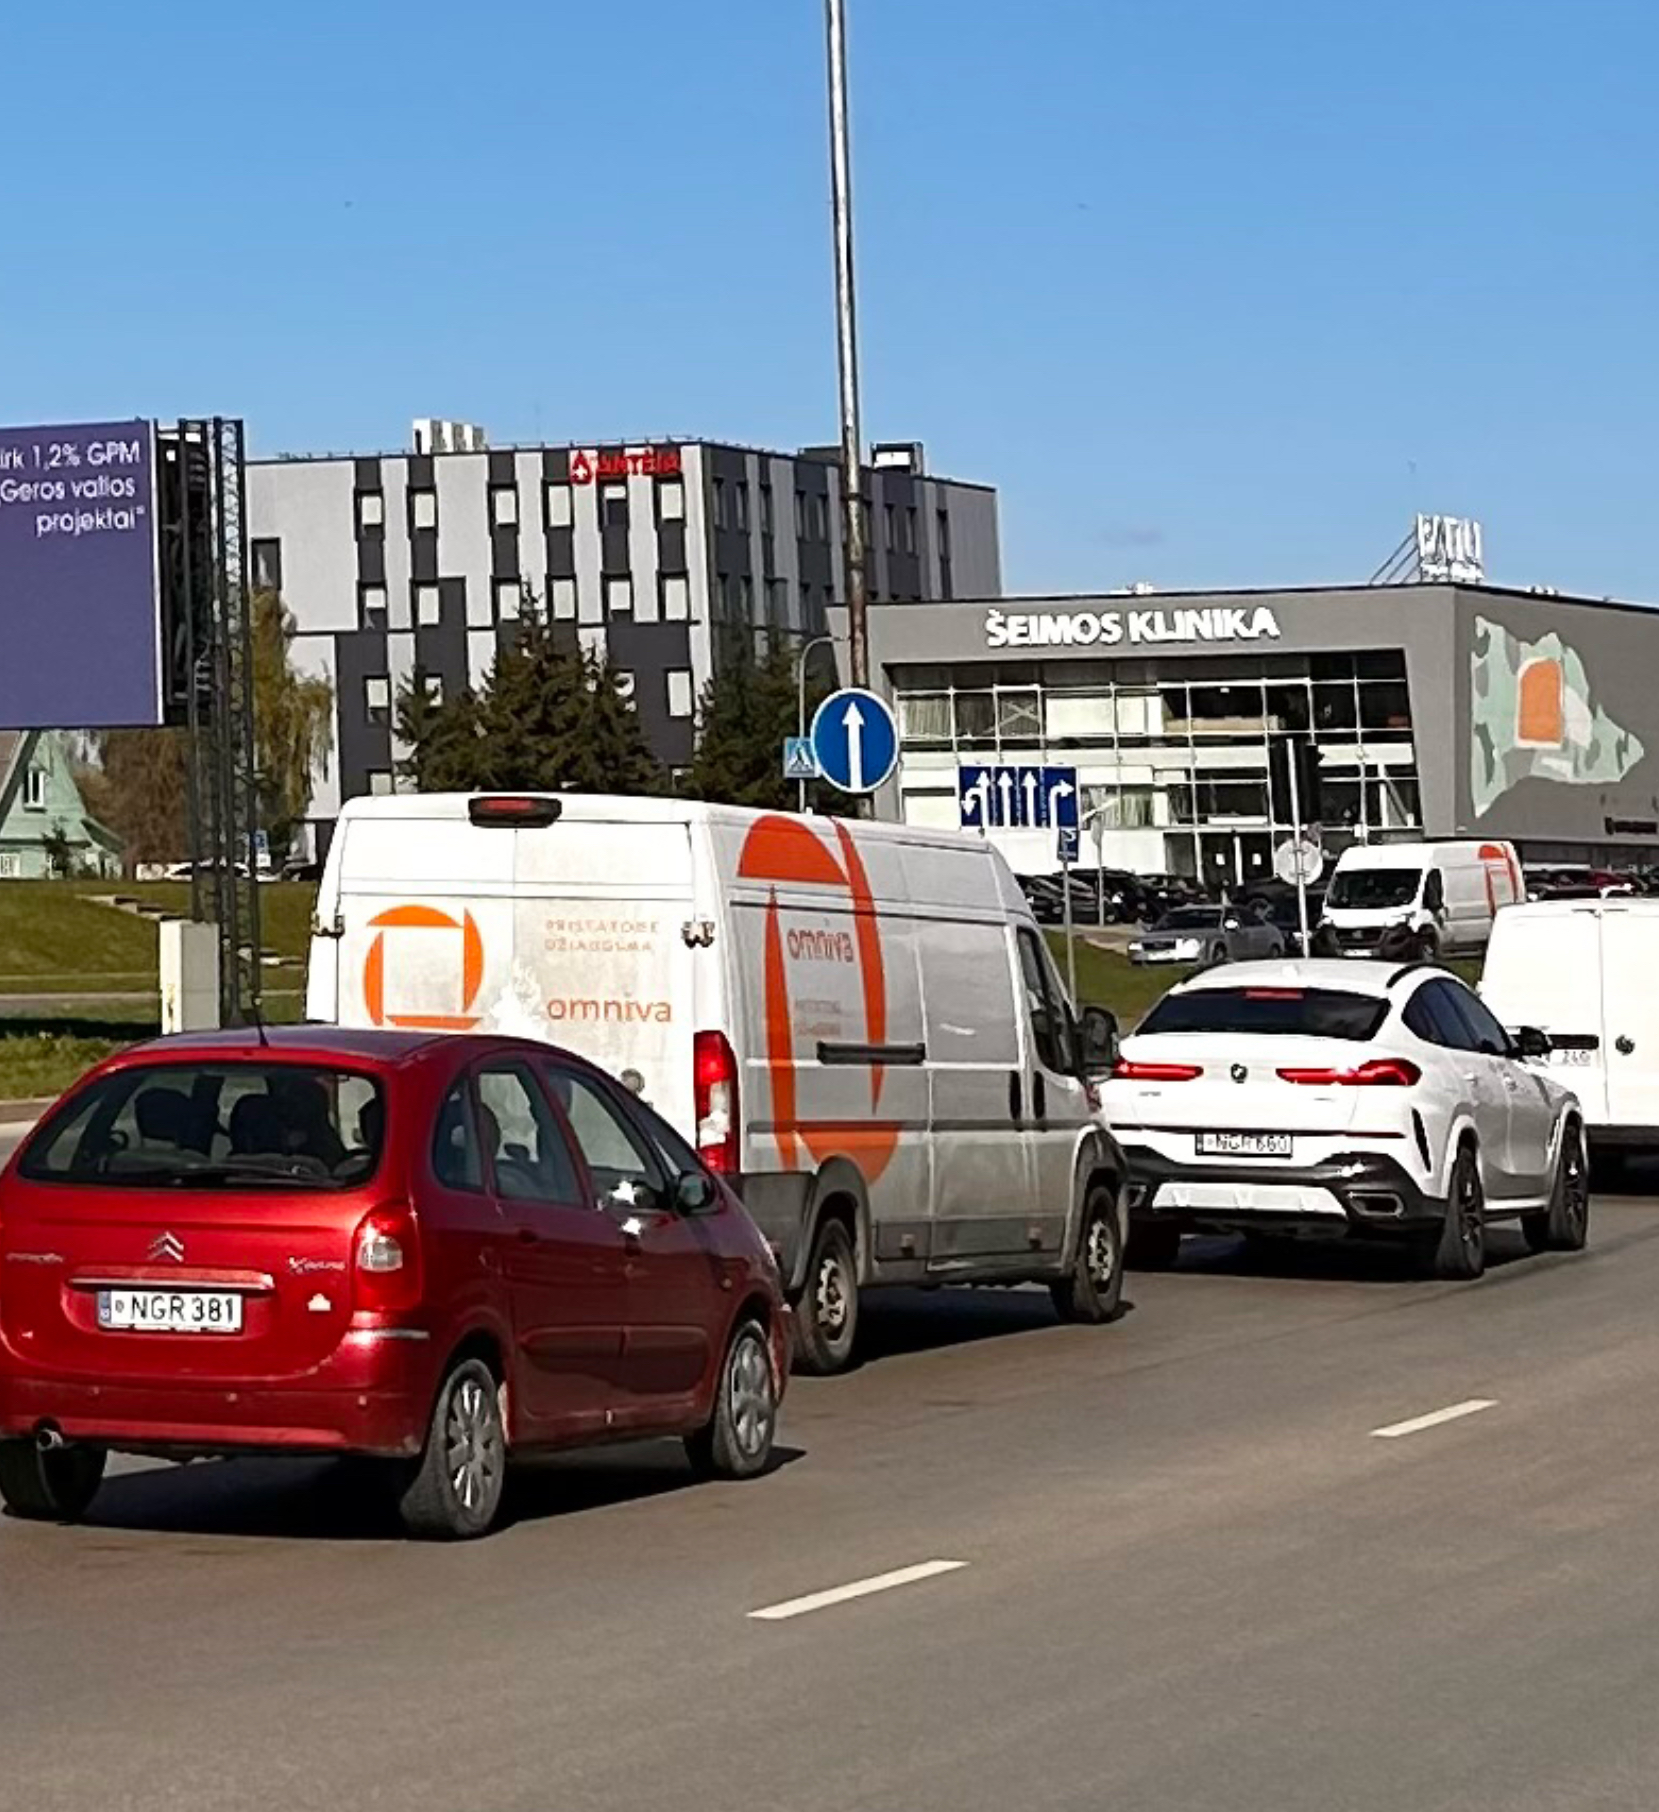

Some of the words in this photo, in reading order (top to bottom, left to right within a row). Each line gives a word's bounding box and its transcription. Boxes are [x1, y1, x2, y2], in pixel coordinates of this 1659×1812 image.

[32, 443, 81, 471] 1,2%
[87, 440, 140, 466] GPM
[985, 609, 1123, 646] ŠEIMOS
[1127, 606, 1281, 642] KLINIKA
[786, 928, 855, 963] omniva
[546, 992, 672, 1023] omniva
[130, 1295, 185, 1321] NGR
[191, 1296, 234, 1322] 381
